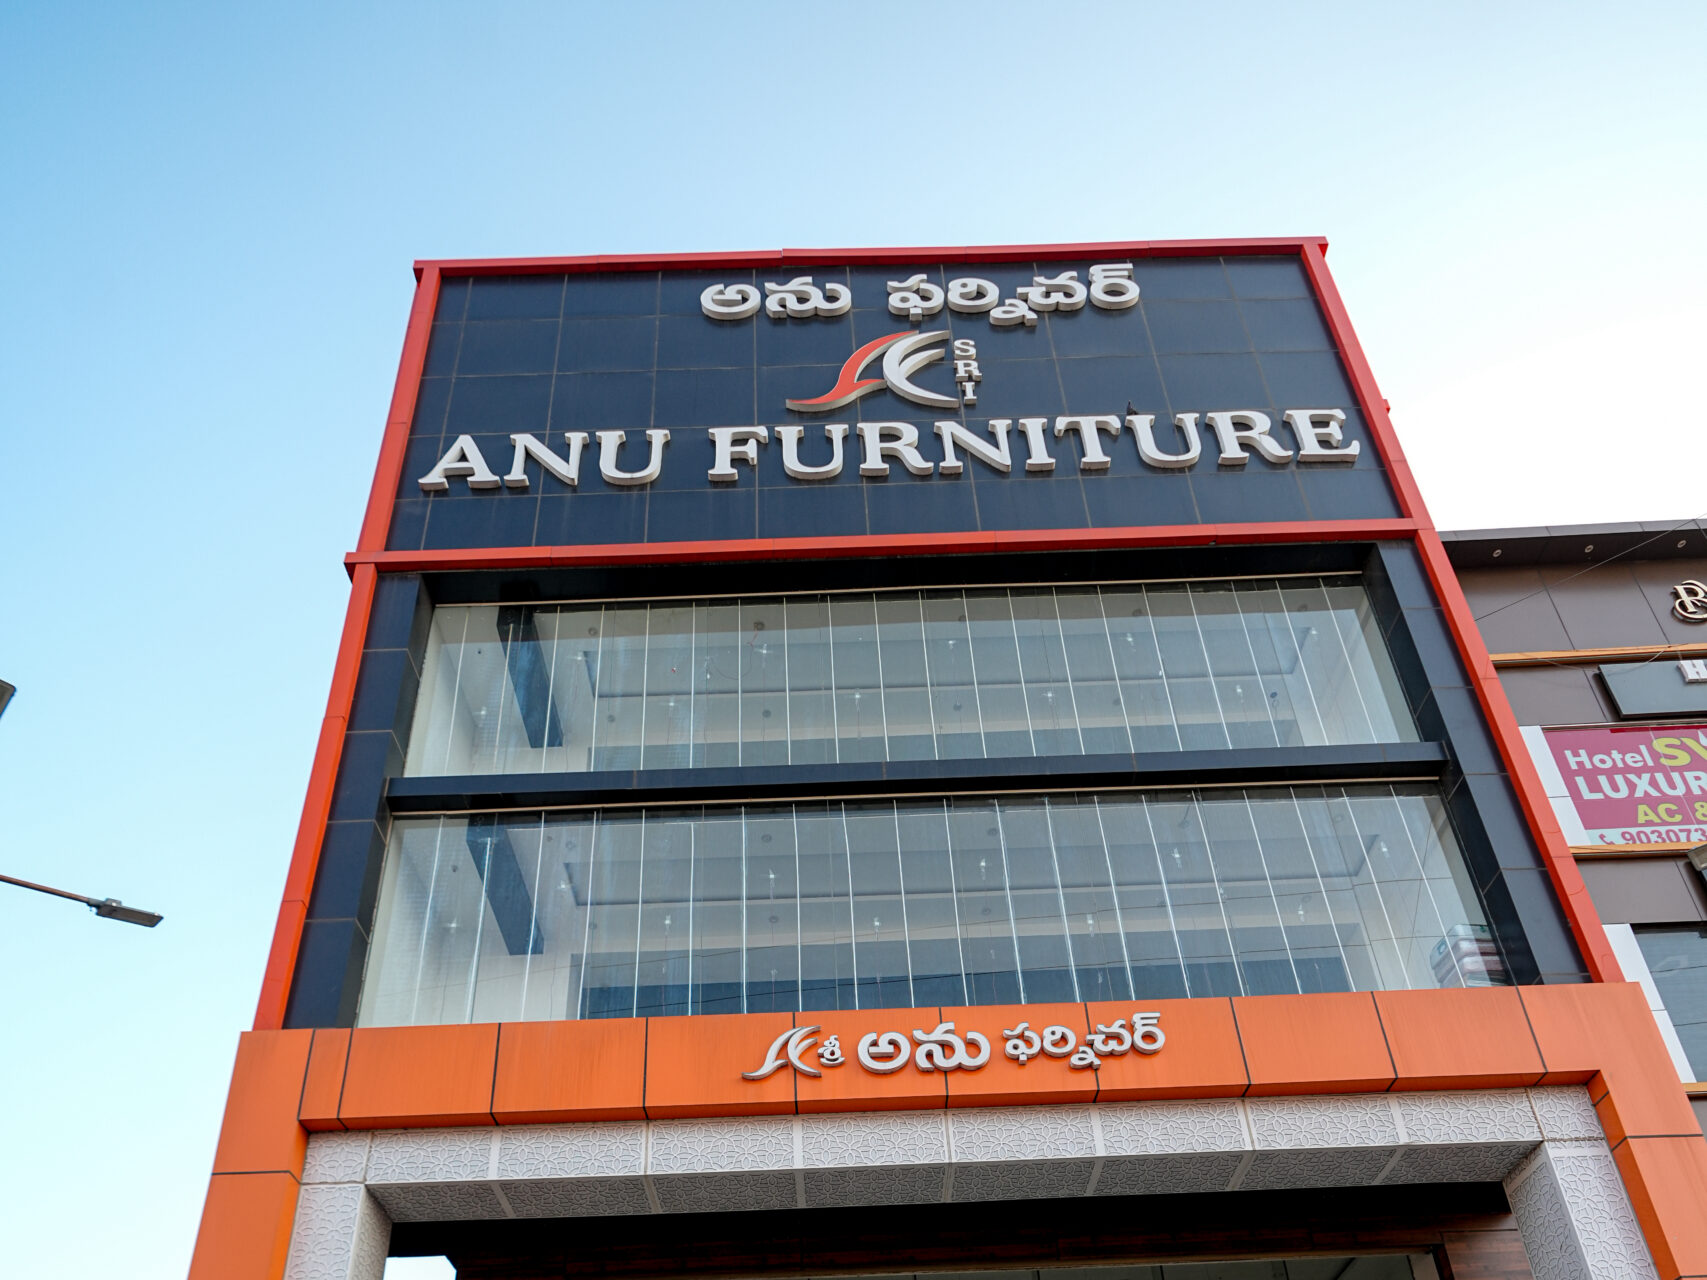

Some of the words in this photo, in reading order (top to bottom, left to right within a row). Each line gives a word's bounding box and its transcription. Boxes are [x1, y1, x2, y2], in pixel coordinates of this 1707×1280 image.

[700, 275, 852, 321] అను
[886, 263, 1141, 327] ఫర్నిచర్
[952, 338, 982, 405] SRI
[417, 428, 671, 491] ANU
[706, 408, 1361, 483] FURNITURE
[1564, 744, 1655, 771] Hotel
[1636, 803, 1683, 825] AC
[857, 1021, 992, 1075] అను
[1002, 1011, 1166, 1070] ఫర్నిచర్
